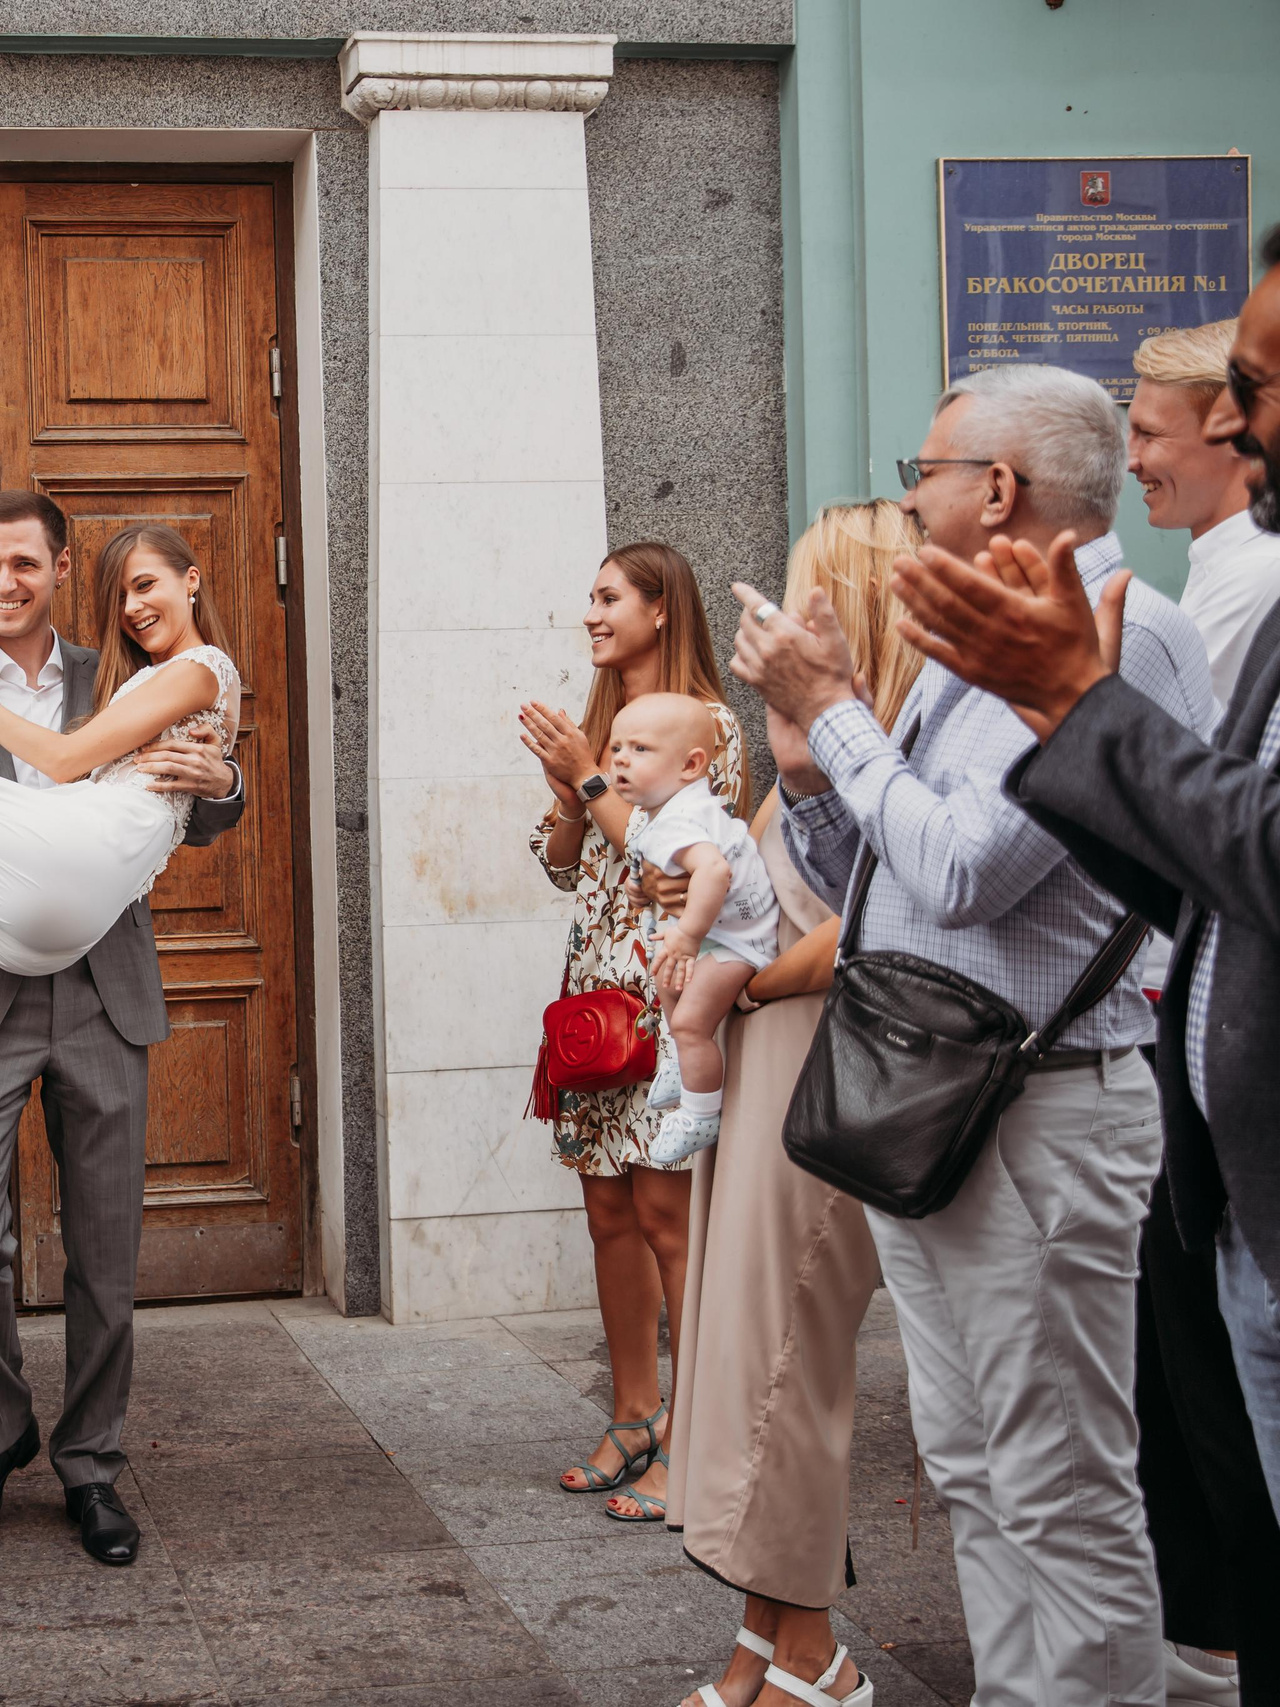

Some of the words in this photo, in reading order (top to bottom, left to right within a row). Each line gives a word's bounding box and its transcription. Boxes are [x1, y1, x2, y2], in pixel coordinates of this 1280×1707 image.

[1036, 213, 1113, 223] Правительство
[1116, 213, 1157, 221] Москвы
[964, 223, 1026, 233] Управление
[1099, 223, 1172, 233] гражданского
[1057, 234, 1093, 243] города
[1095, 233, 1136, 241] Москвы
[1048, 252, 1146, 274] ДВОРЕЦ
[966, 275, 1186, 294] БРАКОСОЧЕТАНИЯ
[1193, 275, 1227, 292] №1
[1051, 304, 1089, 315] ЧАСЫ
[1093, 304, 1144, 314] РАБОТЫ
[968, 322, 1054, 332] ПОНЕДЕЛЬНИК,
[1058, 321, 1112, 331] ВТОРНИК,
[968, 334, 1008, 344] СРЕДА,
[1012, 334, 1063, 343] ЧЕТВЕРГ,
[1066, 333, 1119, 343] ПЯТНИЦА
[968, 348, 1019, 358] СУББОТА
